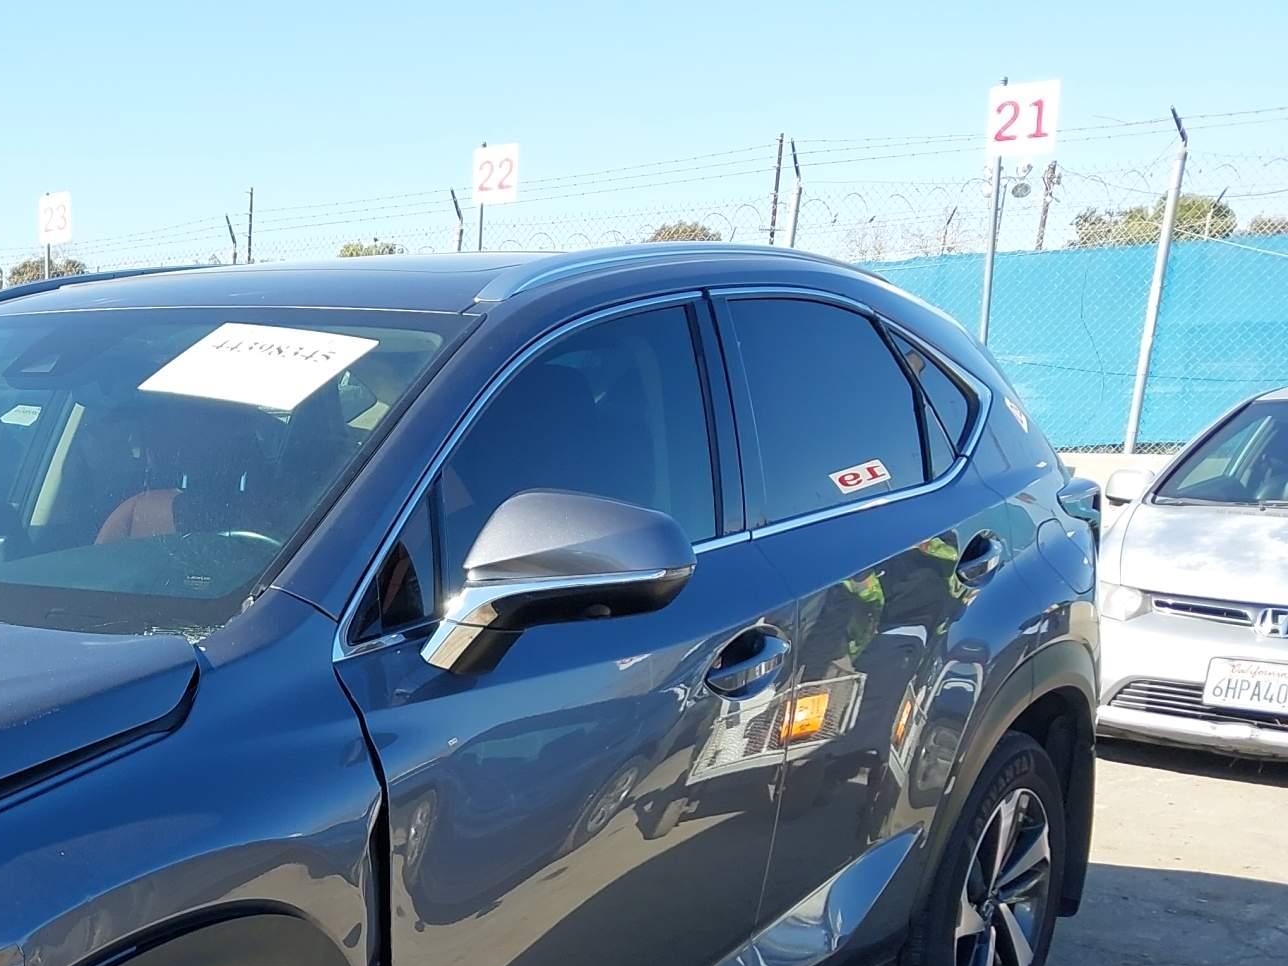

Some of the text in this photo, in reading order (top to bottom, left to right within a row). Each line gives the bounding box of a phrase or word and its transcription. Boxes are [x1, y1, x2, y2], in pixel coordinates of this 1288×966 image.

[994, 99, 1049, 141] 21
[477, 158, 514, 191] 22
[43, 204, 68, 232] 23
